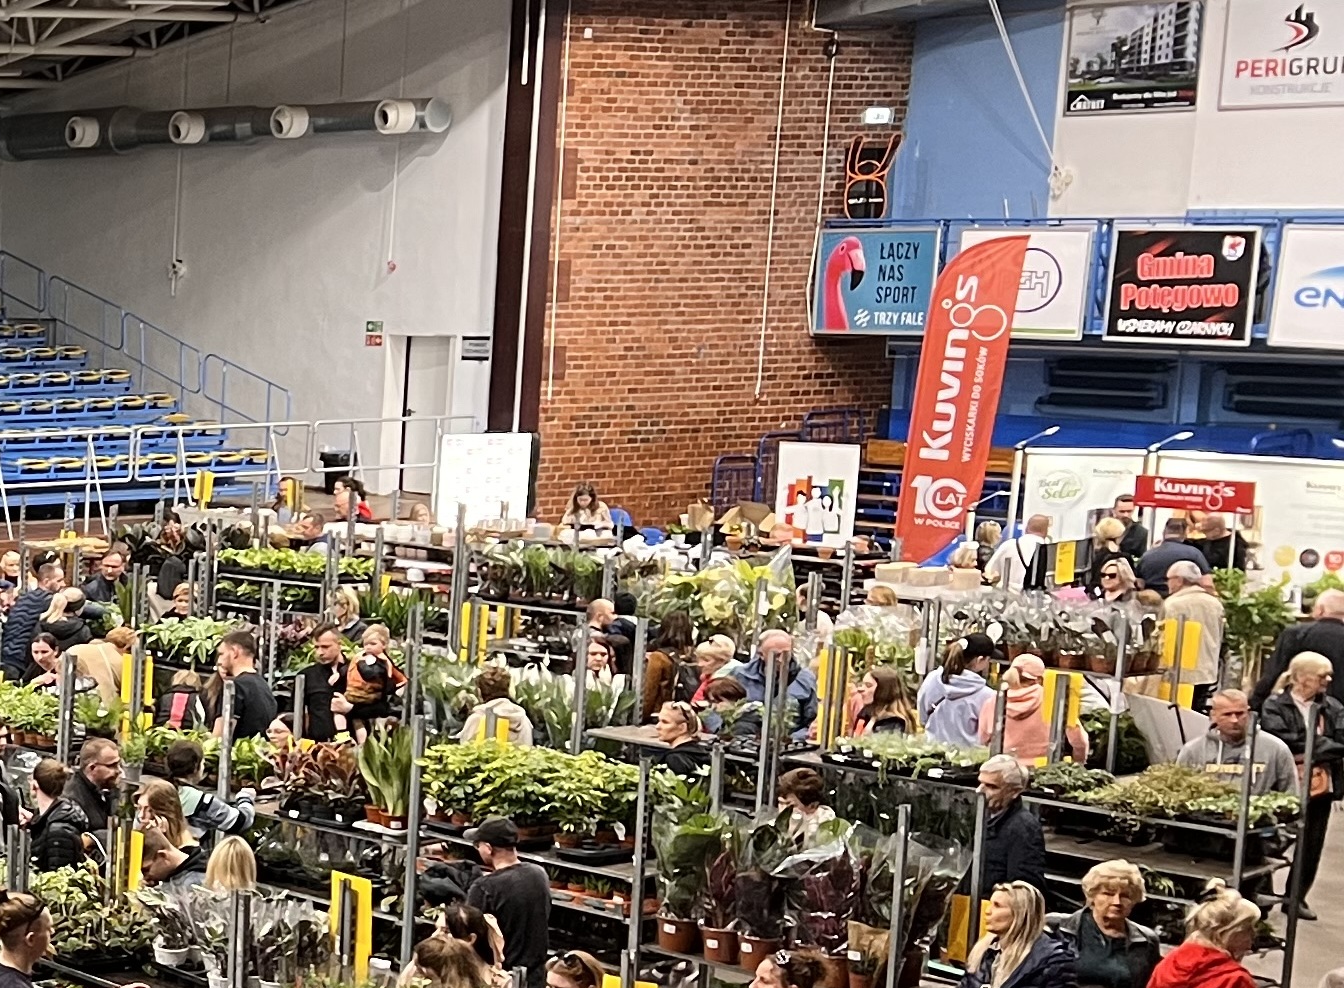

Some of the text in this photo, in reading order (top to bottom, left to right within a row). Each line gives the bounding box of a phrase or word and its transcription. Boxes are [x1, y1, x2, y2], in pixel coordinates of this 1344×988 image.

[879, 242, 920, 262] ŁĄCZY
[877, 264, 904, 282] NAS
[1137, 251, 1215, 280] Gmina
[875, 286, 918, 304] SPORT
[1120, 283, 1240, 313] Potęgowo
[873, 311, 925, 326] TRZY FALE
[1116, 318, 1235, 336] WSPIERAMY CZARNYCH
[960, 397, 984, 463] WYCISKARKI
[972, 384, 983, 400] DO
[910, 474, 968, 520] 10 LAT
[1154, 478, 1236, 510] Kuvings
[913, 517, 960, 530] W POLSCE
